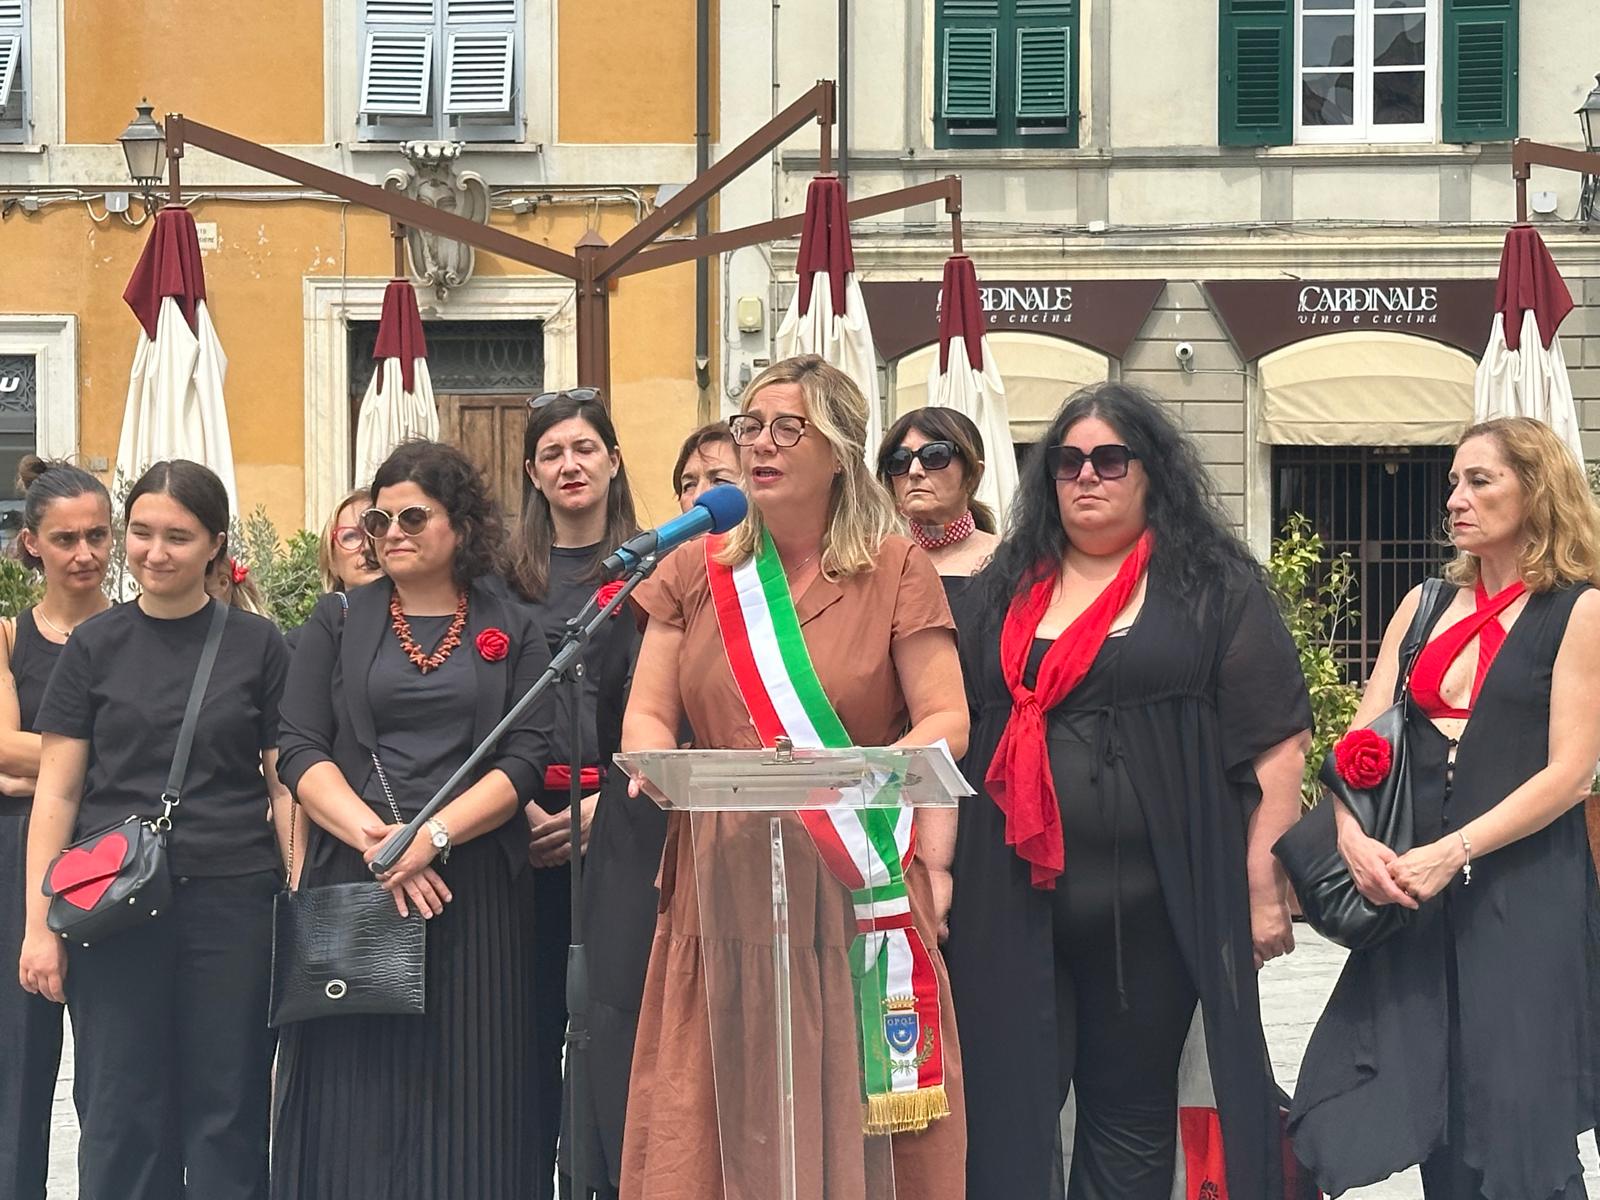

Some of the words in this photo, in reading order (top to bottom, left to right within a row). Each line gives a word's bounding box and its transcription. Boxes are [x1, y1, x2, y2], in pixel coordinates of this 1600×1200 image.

[937, 287, 1073, 311] RDINALE
[1299, 286, 1438, 312] CARDINALE
[990, 314, 998, 323] e
[1009, 312, 1072, 324] cucina
[1298, 312, 1341, 324] vino
[1353, 314, 1361, 324] e
[1372, 312, 1437, 324] cucina
